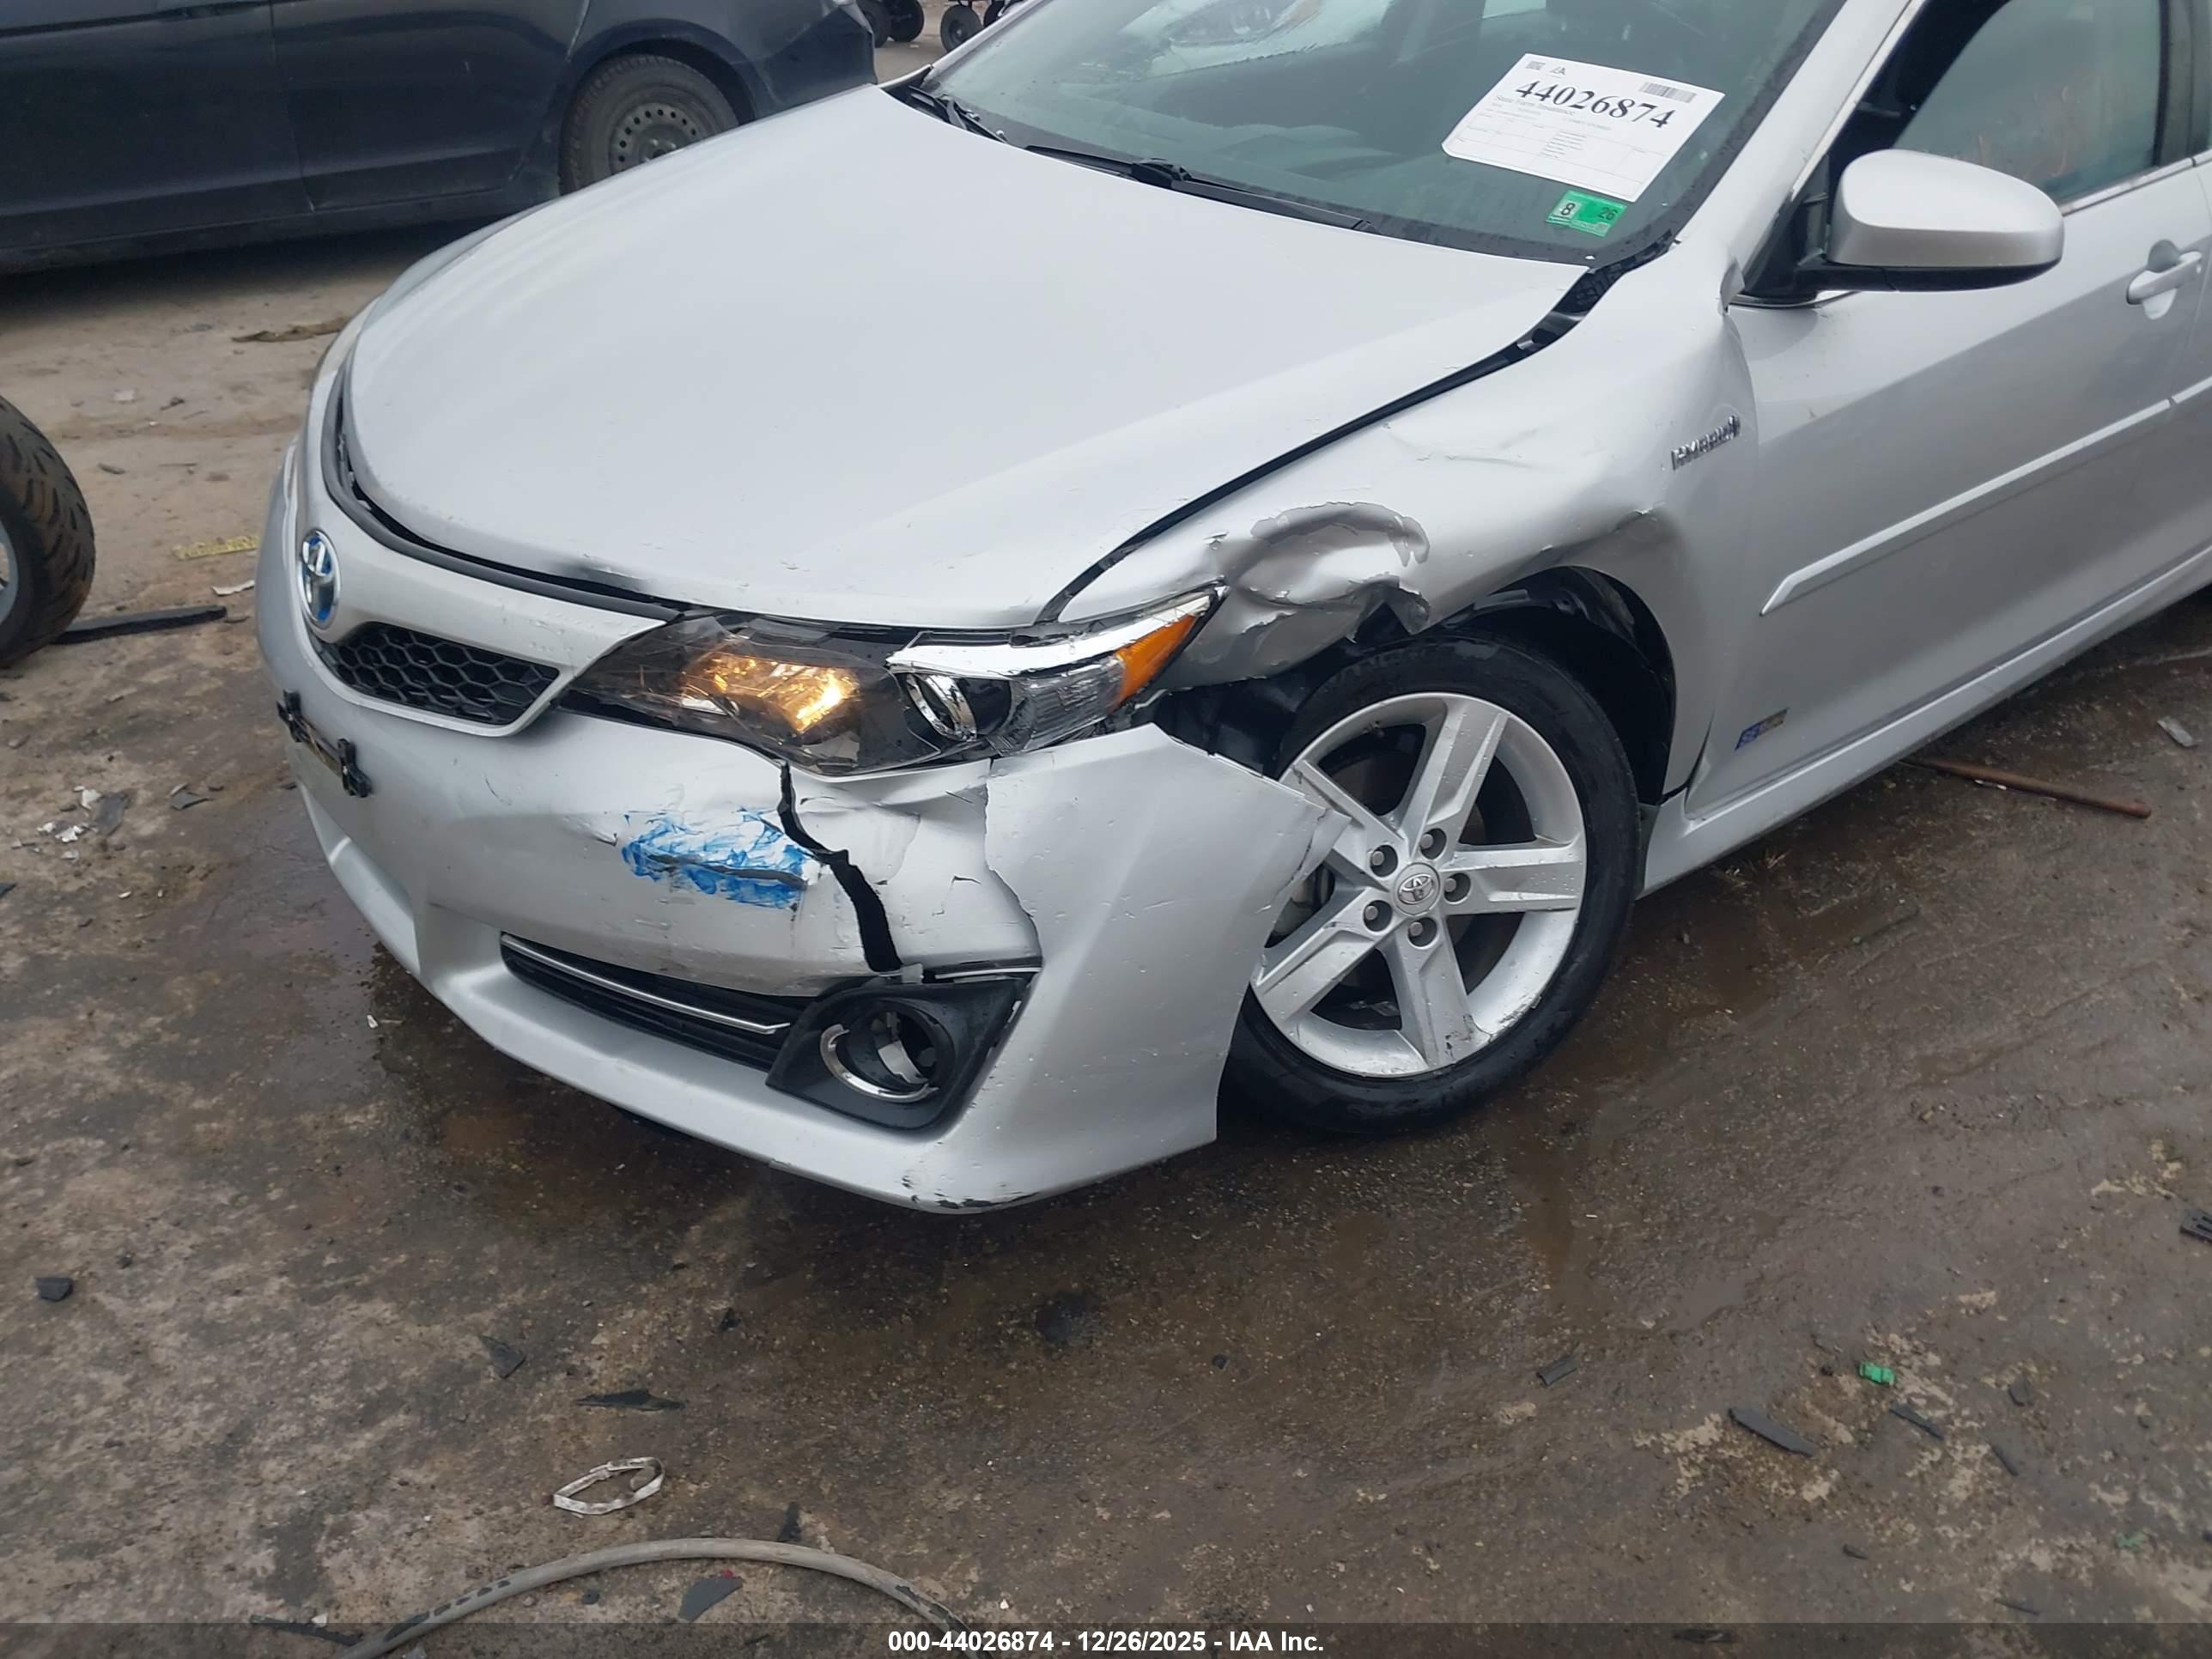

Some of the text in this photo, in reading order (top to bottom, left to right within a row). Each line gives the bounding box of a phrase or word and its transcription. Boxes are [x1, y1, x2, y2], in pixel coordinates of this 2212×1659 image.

[1516, 81, 1676, 128] 44026874
[1560, 203, 1619, 220] 8 26
